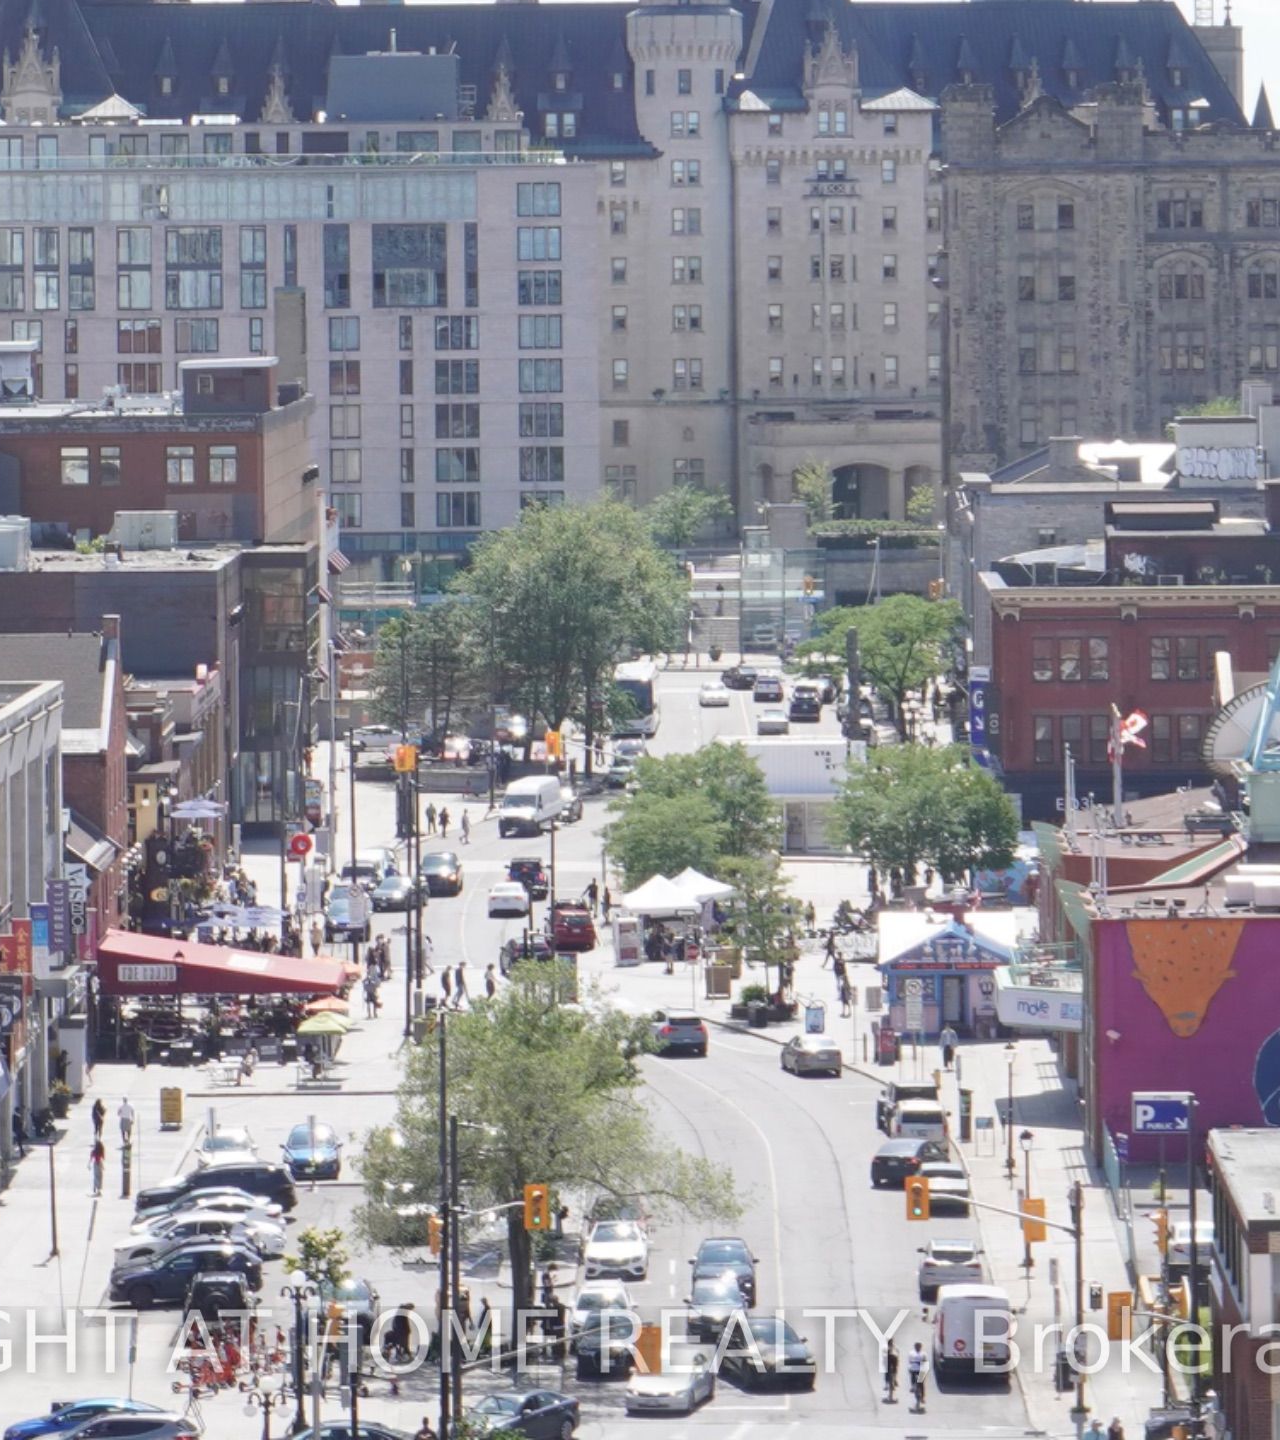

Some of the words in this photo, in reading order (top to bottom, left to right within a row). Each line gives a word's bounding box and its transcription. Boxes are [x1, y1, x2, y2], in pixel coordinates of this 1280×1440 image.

[53, 882, 65, 944] FIORELLA
[1135, 1104, 1156, 1130] P
[1146, 1122, 1173, 1130] PUBLIC
